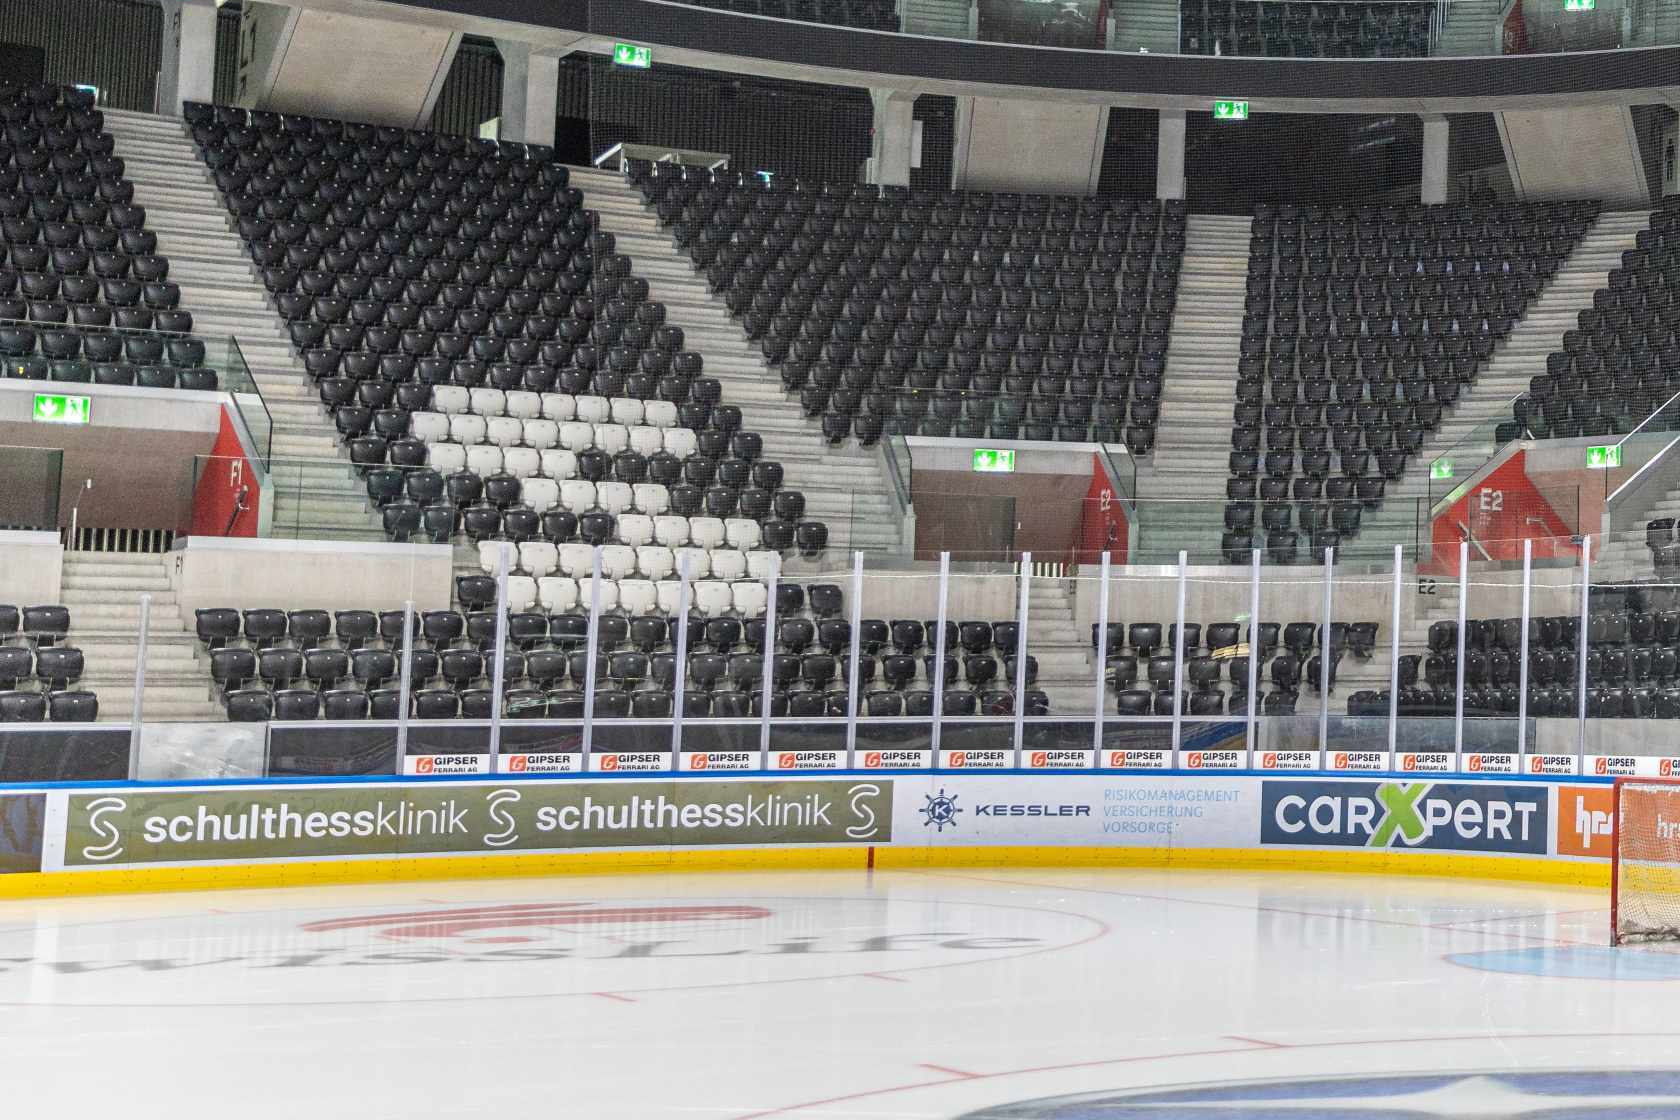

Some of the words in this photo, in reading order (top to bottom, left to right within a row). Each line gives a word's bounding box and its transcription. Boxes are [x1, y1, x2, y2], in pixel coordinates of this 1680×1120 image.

[230, 459, 243, 487] F1
[1480, 487, 1504, 511] E2
[1418, 578, 1436, 595] E2
[528, 754, 570, 764] GIPSER
[619, 754, 660, 763] GIPSER
[708, 753, 749, 762] GIPSER
[796, 752, 836, 761] GIPSER
[882, 751, 921, 760] GIPSER
[966, 752, 1004, 760] GIPSER
[1047, 752, 1084, 761] GIPSER
[1125, 752, 1162, 761] GIPSER
[1203, 752, 1237, 761] GIPSER
[1277, 753, 1310, 761] GIPSER
[1348, 753, 1380, 762] GIPSER
[1416, 754, 1447, 764] GIPSER
[1481, 755, 1511, 764] GIPSER
[433, 756, 477, 766] GIPSER
[1543, 757, 1571, 766] GIPSER
[1608, 758, 1635, 767] GIPSER
[1104, 788, 1241, 802] RISIKOMANAGEMENT
[975, 804, 1091, 817] KESSLER
[1103, 805, 1204, 818] VERSICHERUNG
[1102, 820, 1173, 833] VORSORGE
